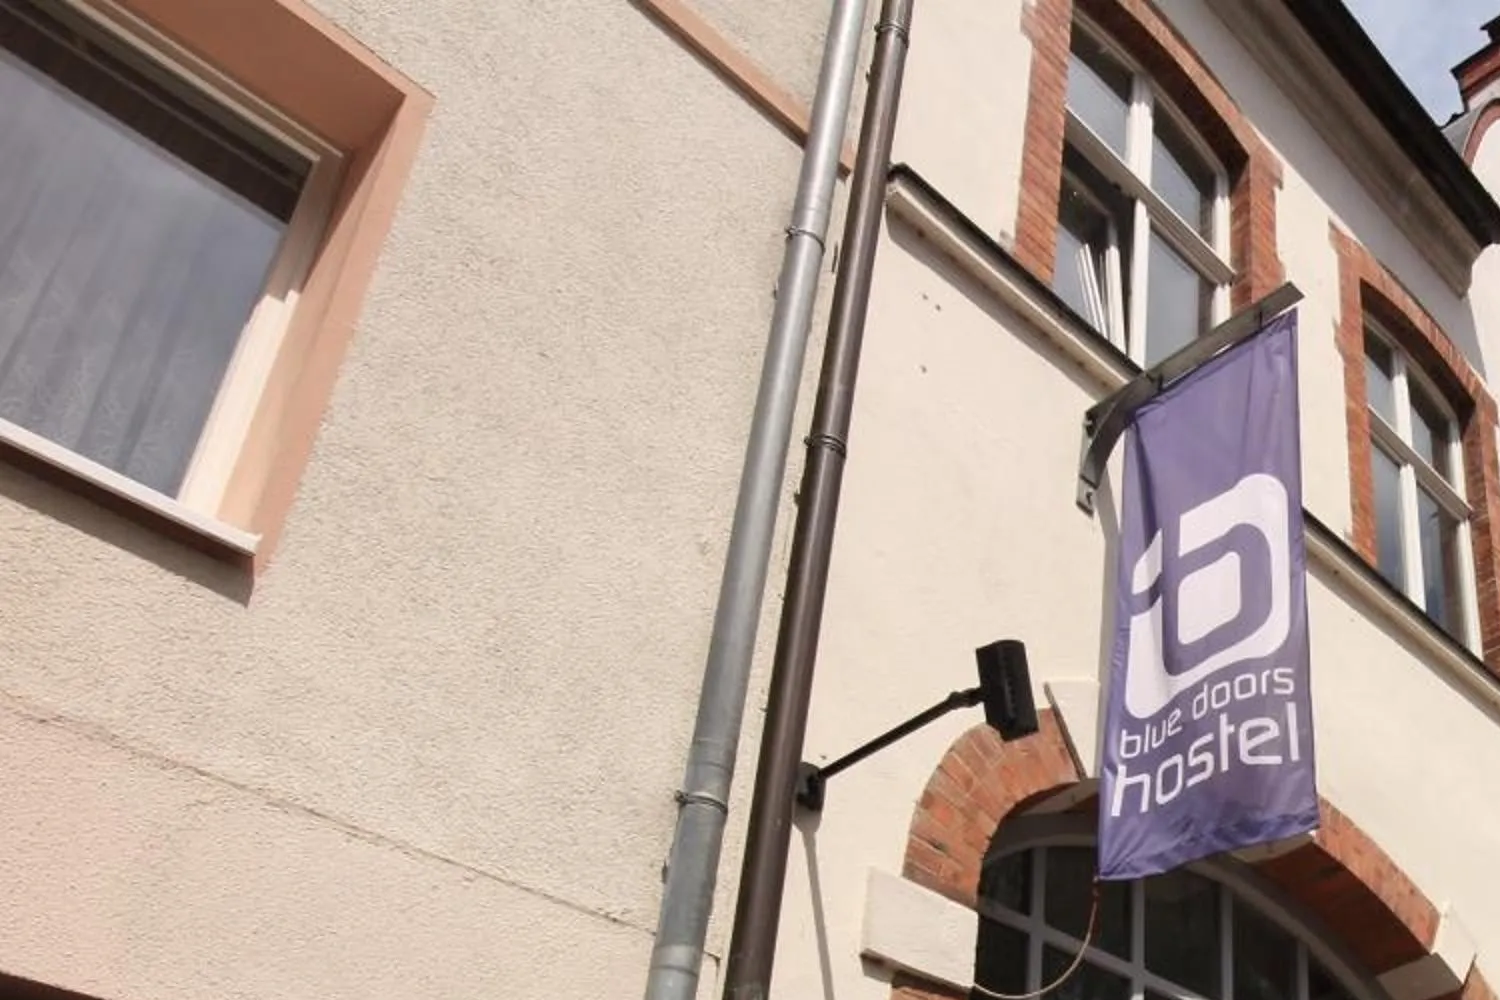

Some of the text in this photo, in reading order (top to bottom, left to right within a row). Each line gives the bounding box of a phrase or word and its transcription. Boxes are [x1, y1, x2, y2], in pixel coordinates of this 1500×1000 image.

[1110, 703, 1300, 817] hostel
[1119, 666, 1295, 759] blue doors
